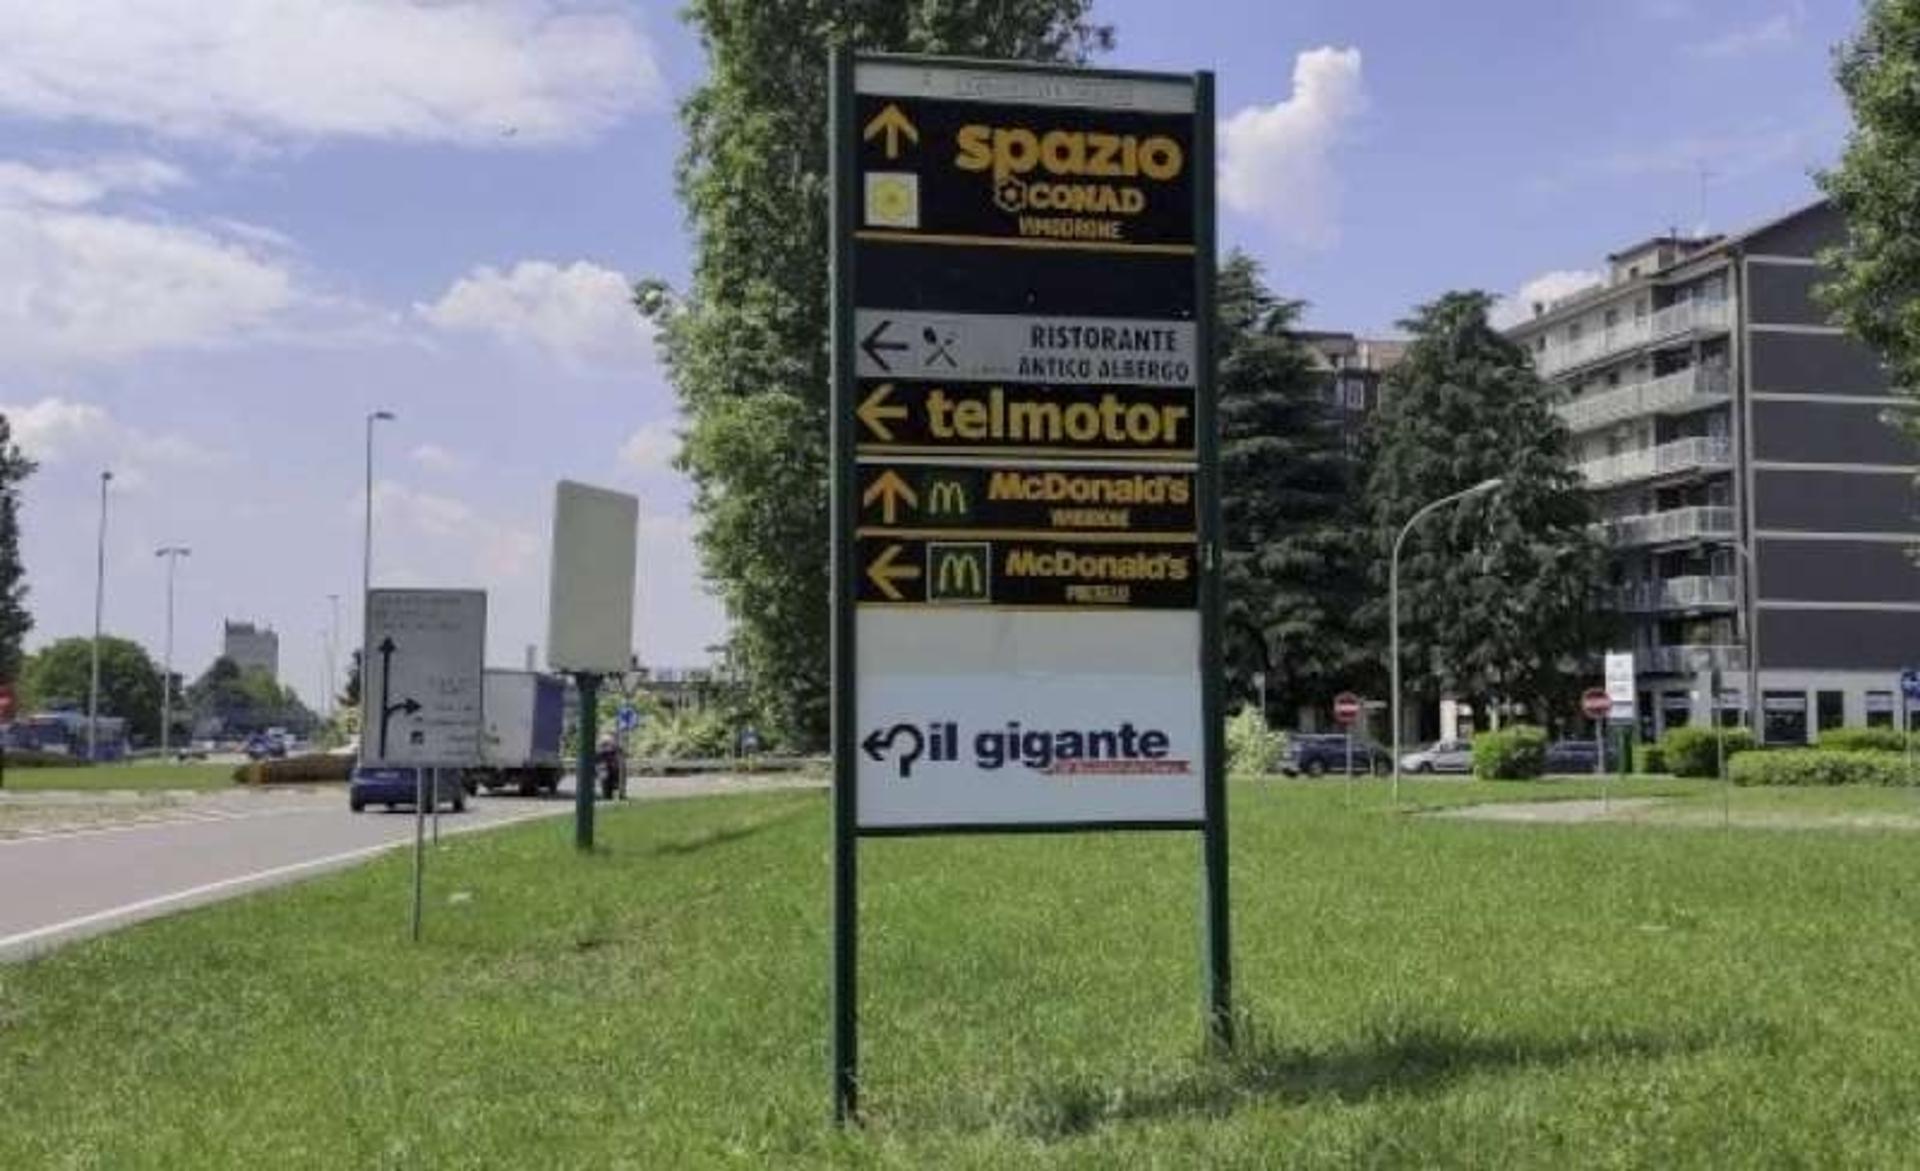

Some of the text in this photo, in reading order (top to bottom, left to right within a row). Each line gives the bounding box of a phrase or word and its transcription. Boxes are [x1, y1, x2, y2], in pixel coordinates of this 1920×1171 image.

[956, 124, 1183, 181] spazio
[1028, 183, 1144, 213] CONAD
[1030, 325, 1177, 352] RISTORANTE
[1018, 357, 1189, 381] ANTICO ALBERGO
[927, 387, 1188, 442] telmotor
[988, 472, 1189, 502] McDonald's
[1005, 552, 1188, 580] McDonald's
[929, 721, 1170, 769] il gigante
